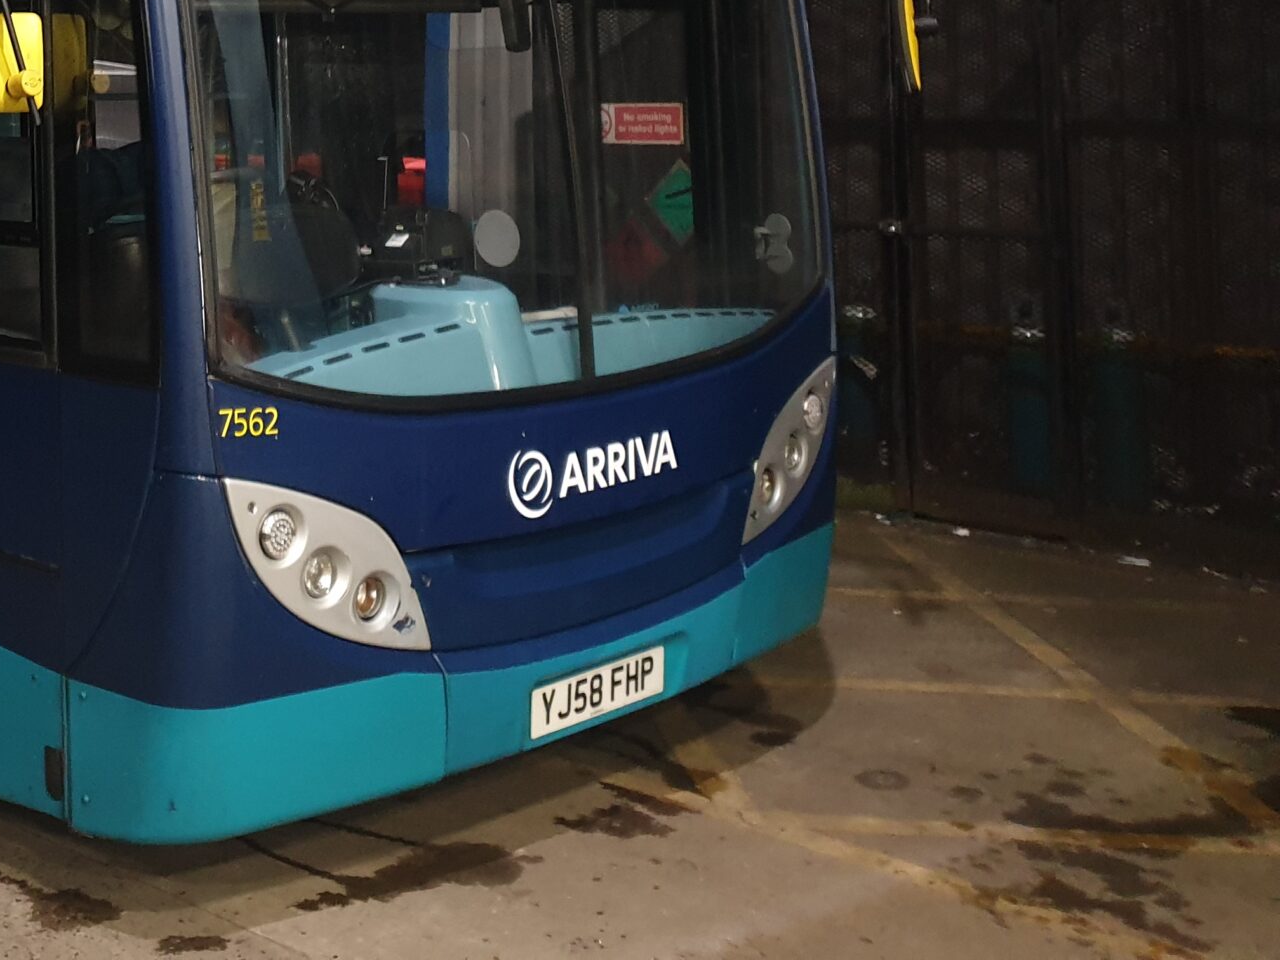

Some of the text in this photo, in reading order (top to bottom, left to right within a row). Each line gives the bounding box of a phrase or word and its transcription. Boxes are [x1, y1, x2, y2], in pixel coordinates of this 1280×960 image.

[623, 112, 636, 122] No
[218, 405, 279, 438] 7562
[559, 429, 678, 499] ARRIVA
[541, 655, 655, 726] YJ58 FHP
